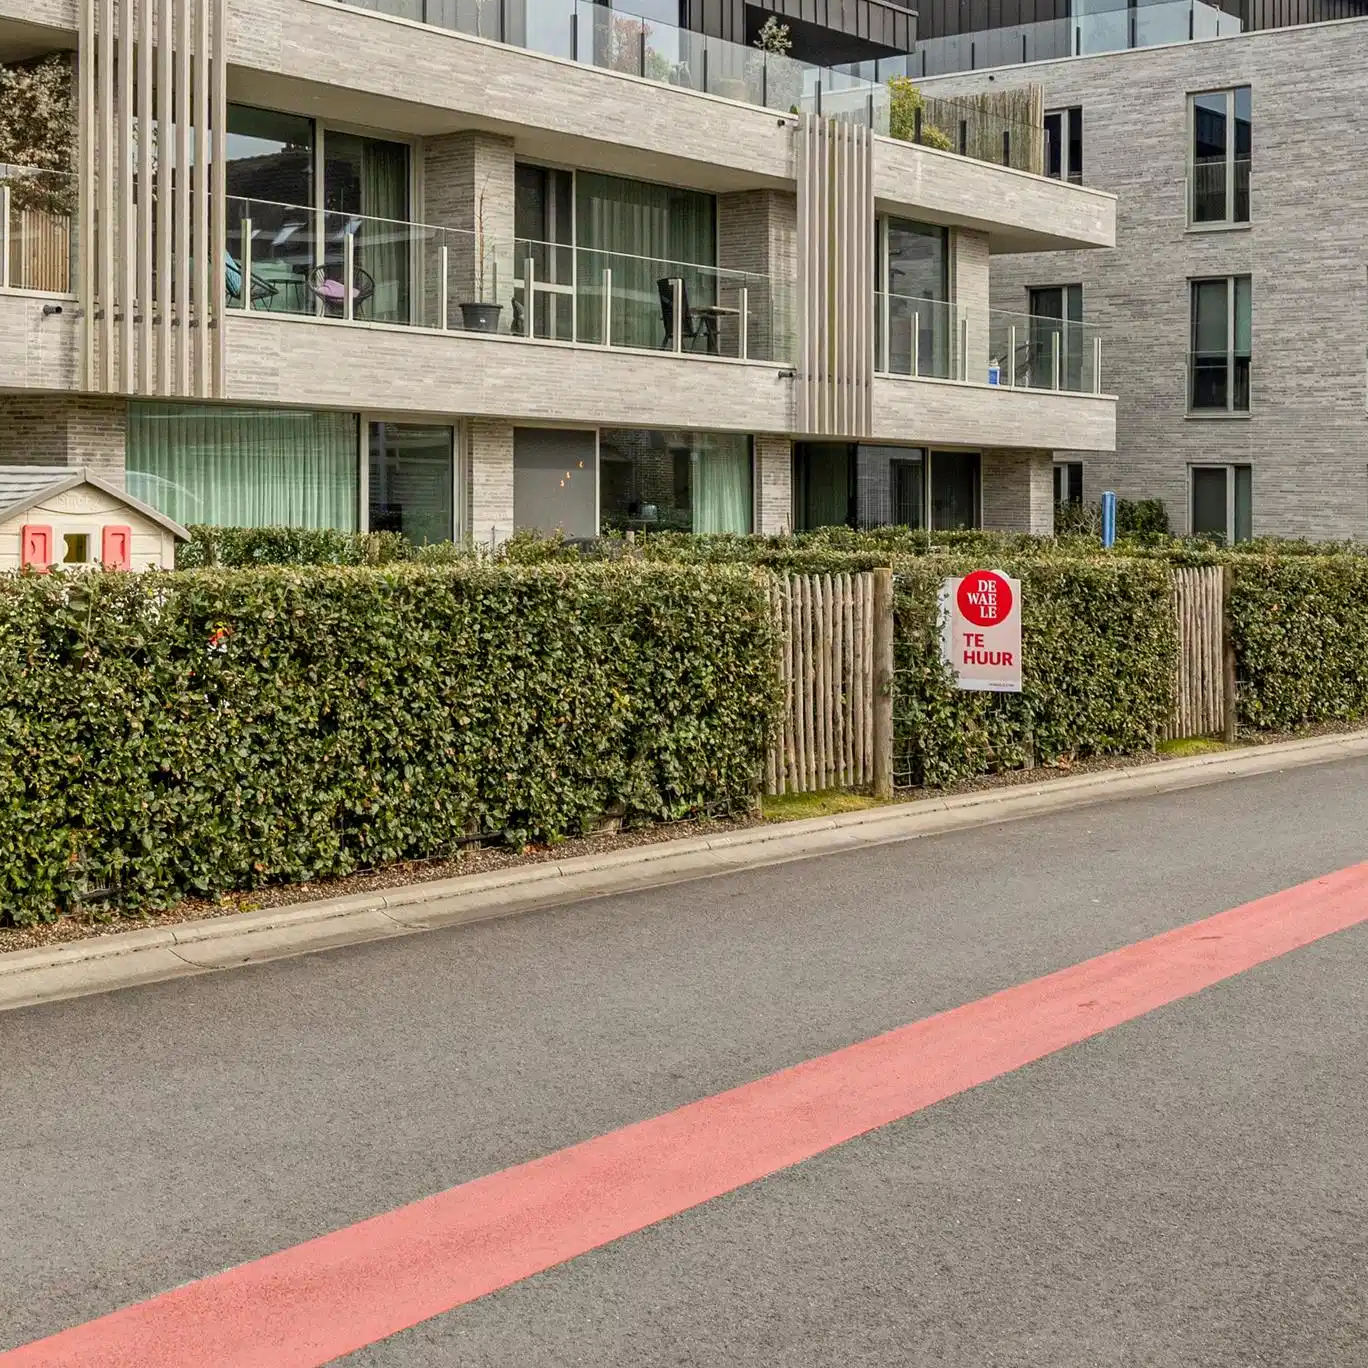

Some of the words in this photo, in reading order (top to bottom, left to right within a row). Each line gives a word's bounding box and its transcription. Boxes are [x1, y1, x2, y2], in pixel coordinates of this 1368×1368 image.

[977, 579, 997, 593] DE
[967, 592, 997, 606] WAE
[979, 606, 997, 619] LE
[963, 633, 985, 648] TE
[963, 650, 1013, 666] HUUR
